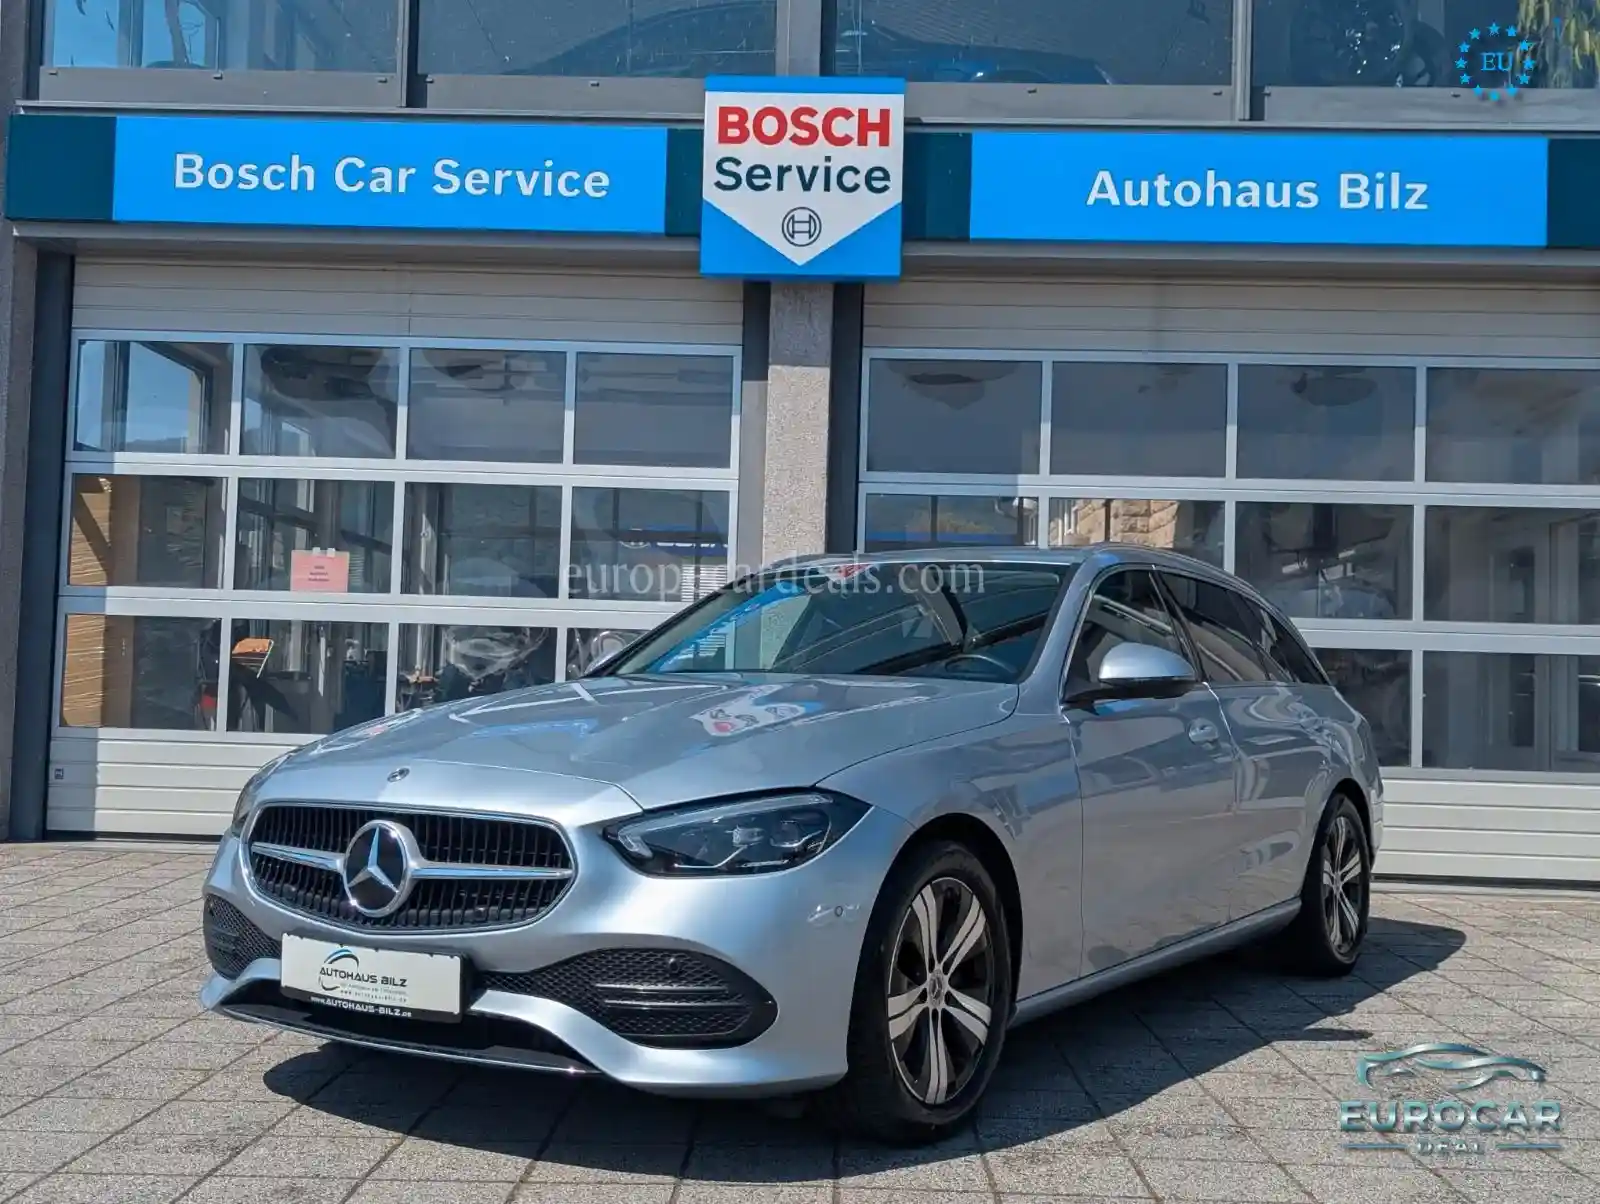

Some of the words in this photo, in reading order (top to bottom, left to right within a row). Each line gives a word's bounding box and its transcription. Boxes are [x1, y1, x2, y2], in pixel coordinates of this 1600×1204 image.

[717, 106, 891, 147] BOSCH
[174, 152, 316, 192] Bosch
[333, 156, 416, 194] Car
[432, 157, 611, 199] Service
[713, 155, 892, 195] Service
[1086, 169, 1320, 209] Autohaus
[1338, 171, 1430, 211] Bilz
[319, 967, 378, 984] AUTOHAUS
[381, 976, 408, 988] BILZ
